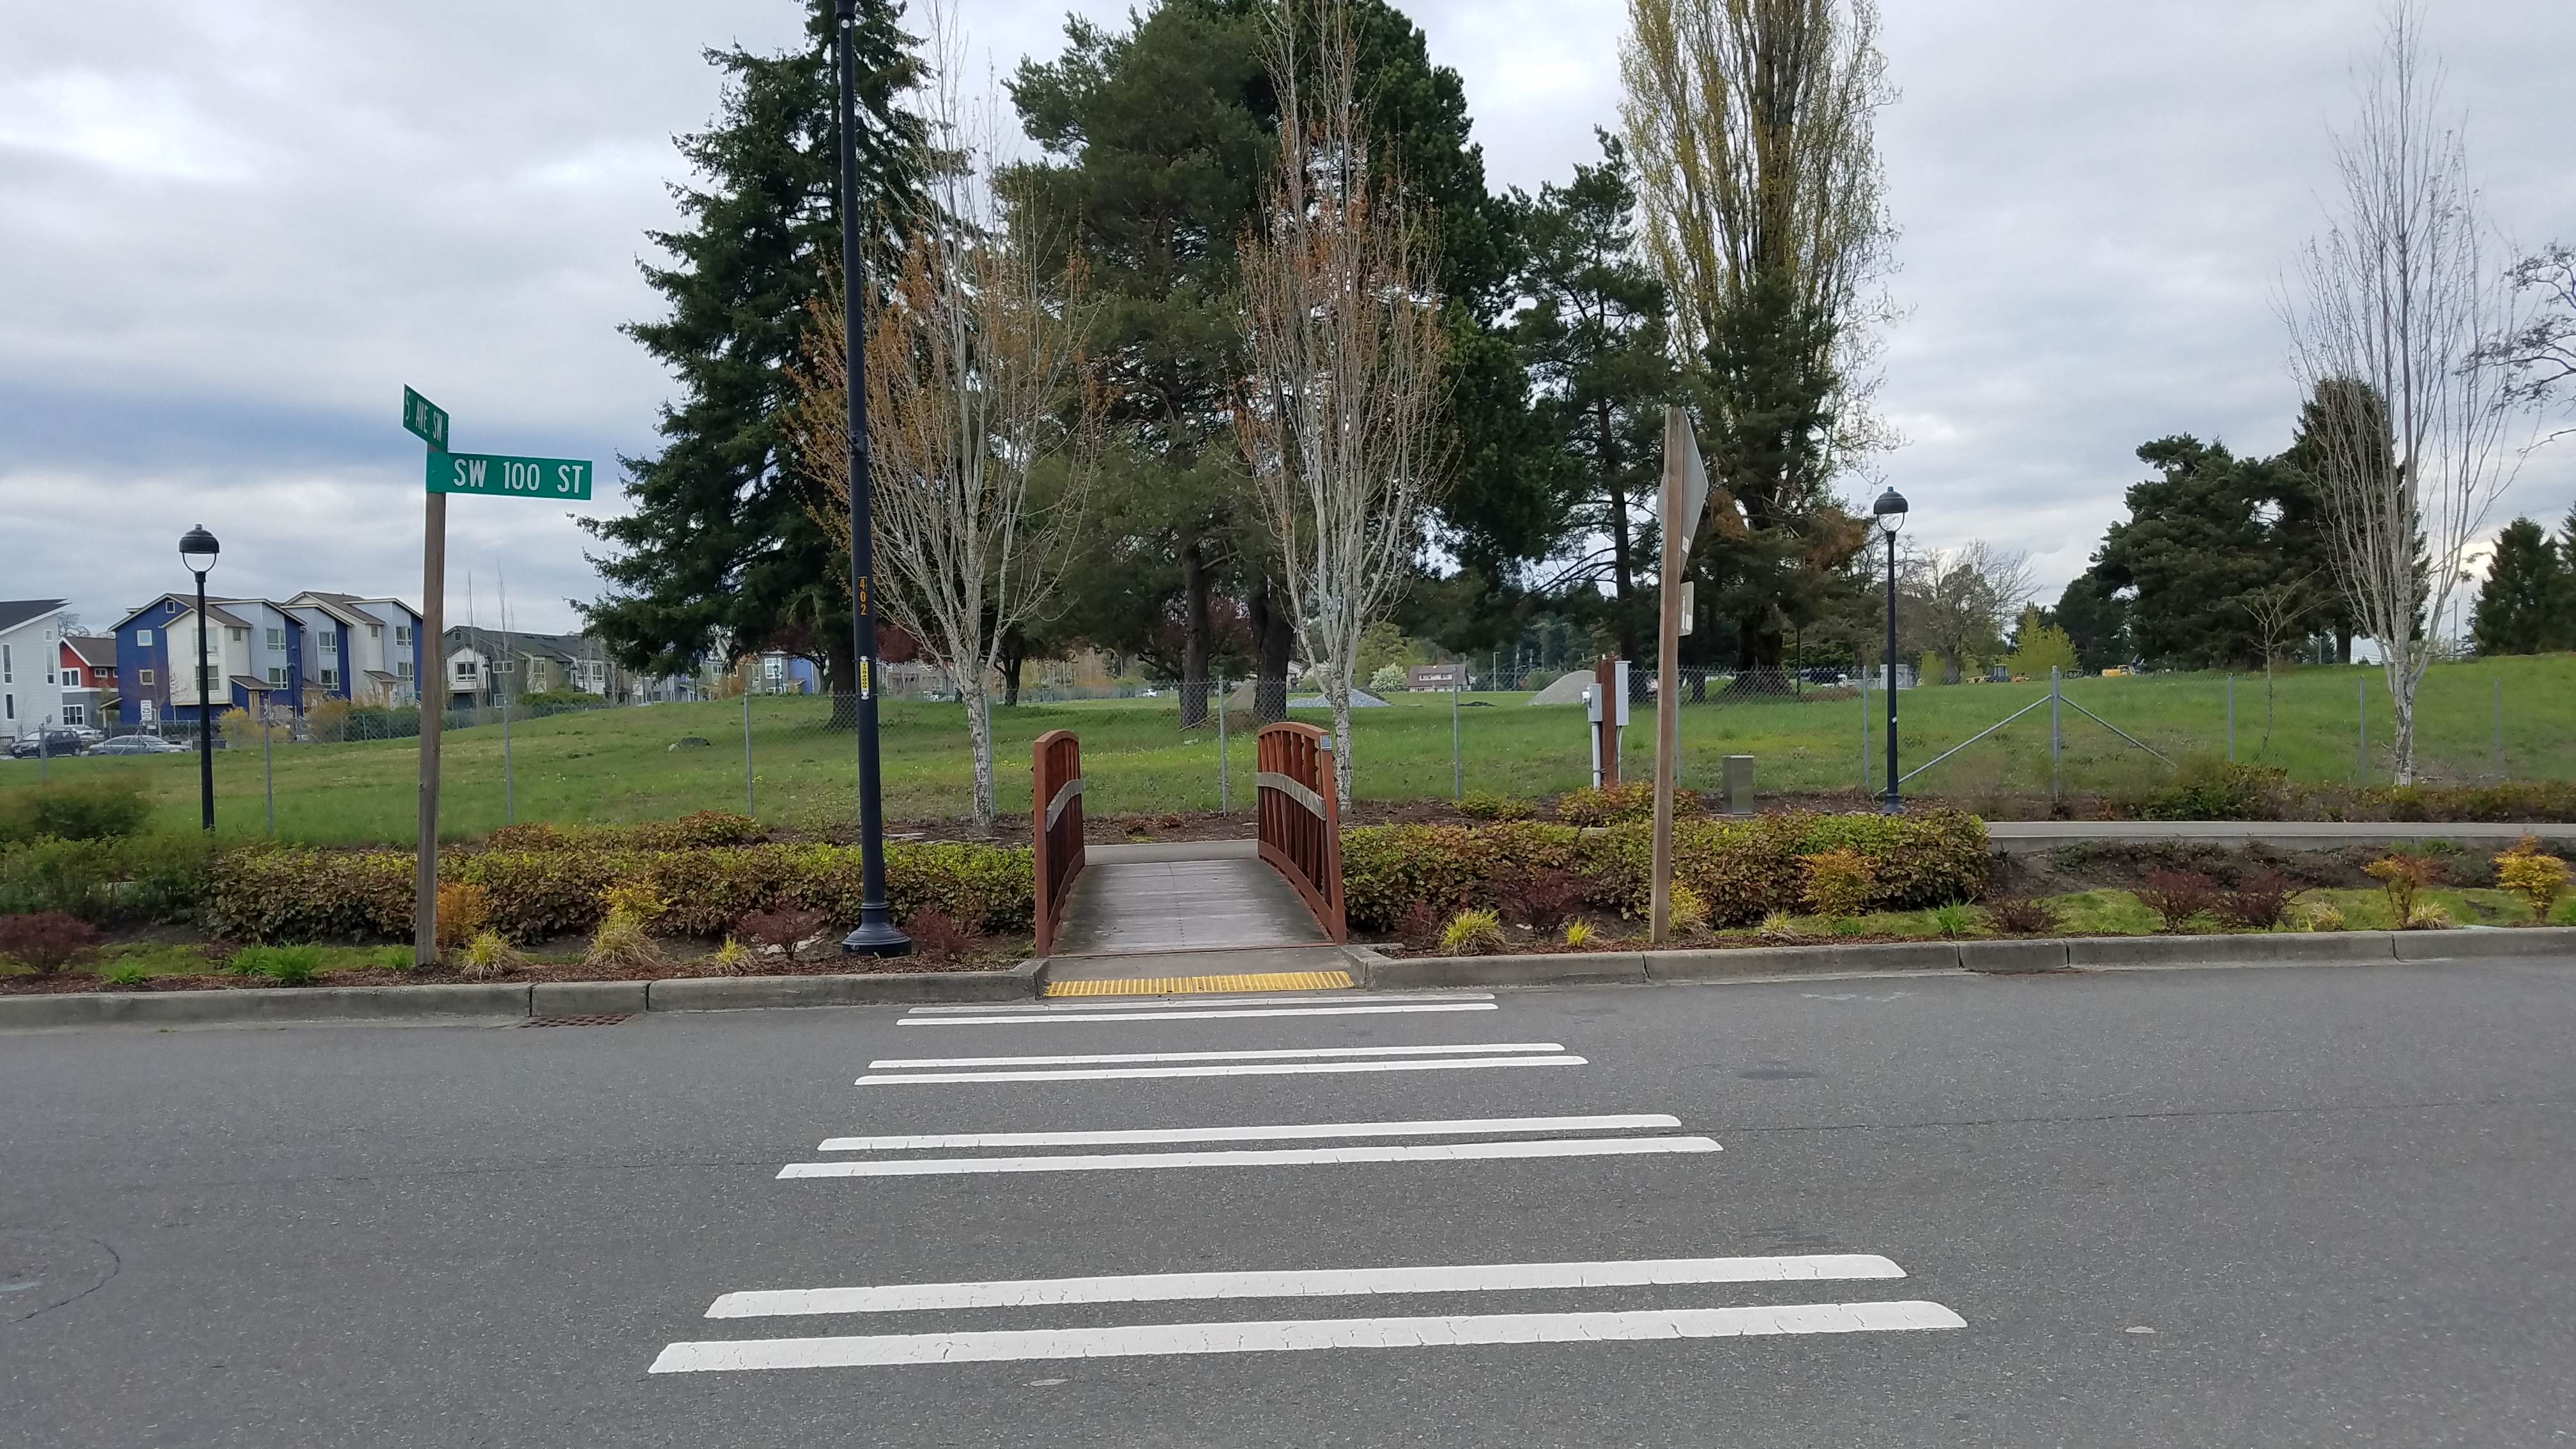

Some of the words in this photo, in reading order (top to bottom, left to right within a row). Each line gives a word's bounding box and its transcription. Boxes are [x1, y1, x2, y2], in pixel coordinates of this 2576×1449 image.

[405, 390, 410, 420] 5
[415, 399, 429, 434] AVE
[433, 410, 443, 442] SW
[453, 459, 487, 487] SW
[503, 461, 540, 491] 100
[556, 464, 584, 493] ST
